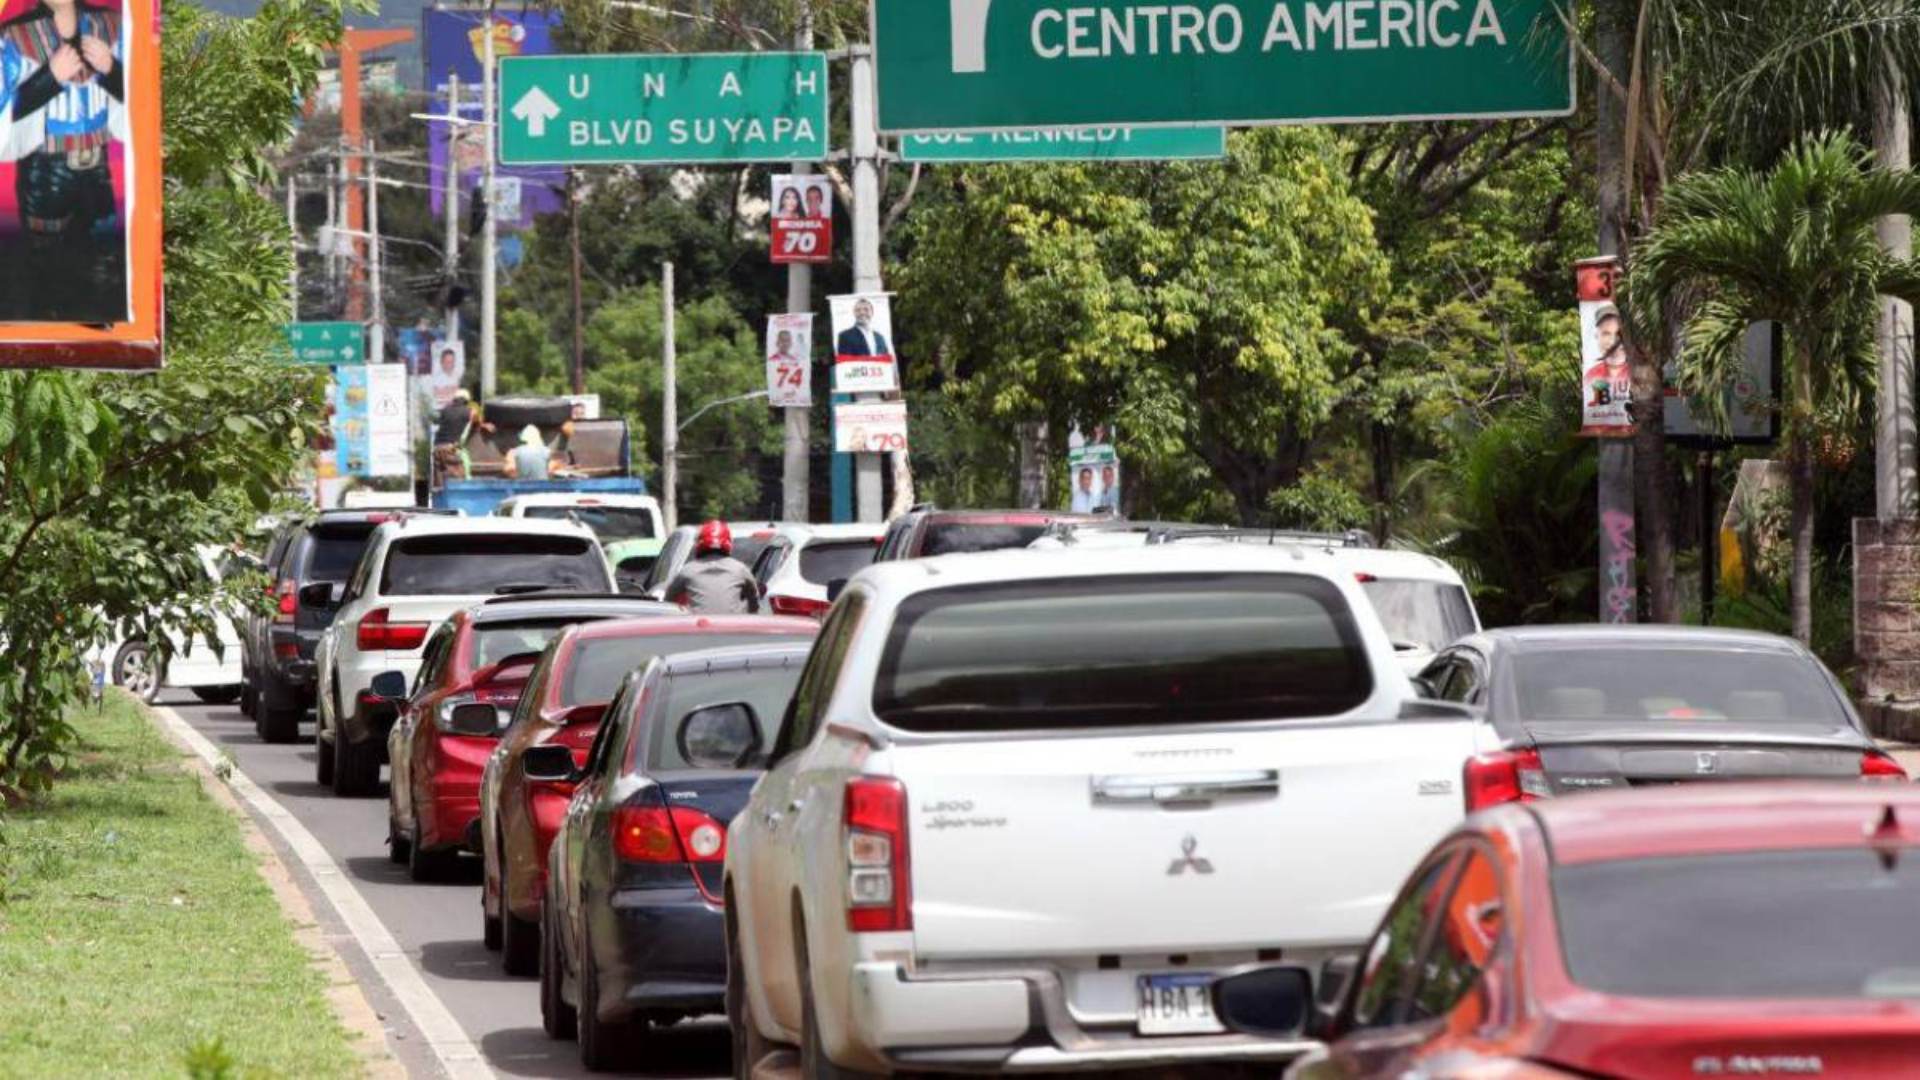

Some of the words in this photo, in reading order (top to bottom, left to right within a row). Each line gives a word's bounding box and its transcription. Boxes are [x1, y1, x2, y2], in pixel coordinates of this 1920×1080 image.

[1031, 4, 1243, 58] CENTRO
[1261, 0, 1507, 52] AMERICA
[569, 75, 590, 98] U
[644, 74, 665, 97] N
[719, 72, 741, 96] A
[796, 71, 816, 95] H
[570, 120, 652, 146] BLVD
[670, 118, 815, 144] SUYAPA
[784, 231, 817, 253] 70
[776, 366, 804, 388] 74
[872, 432, 906, 455] 79
